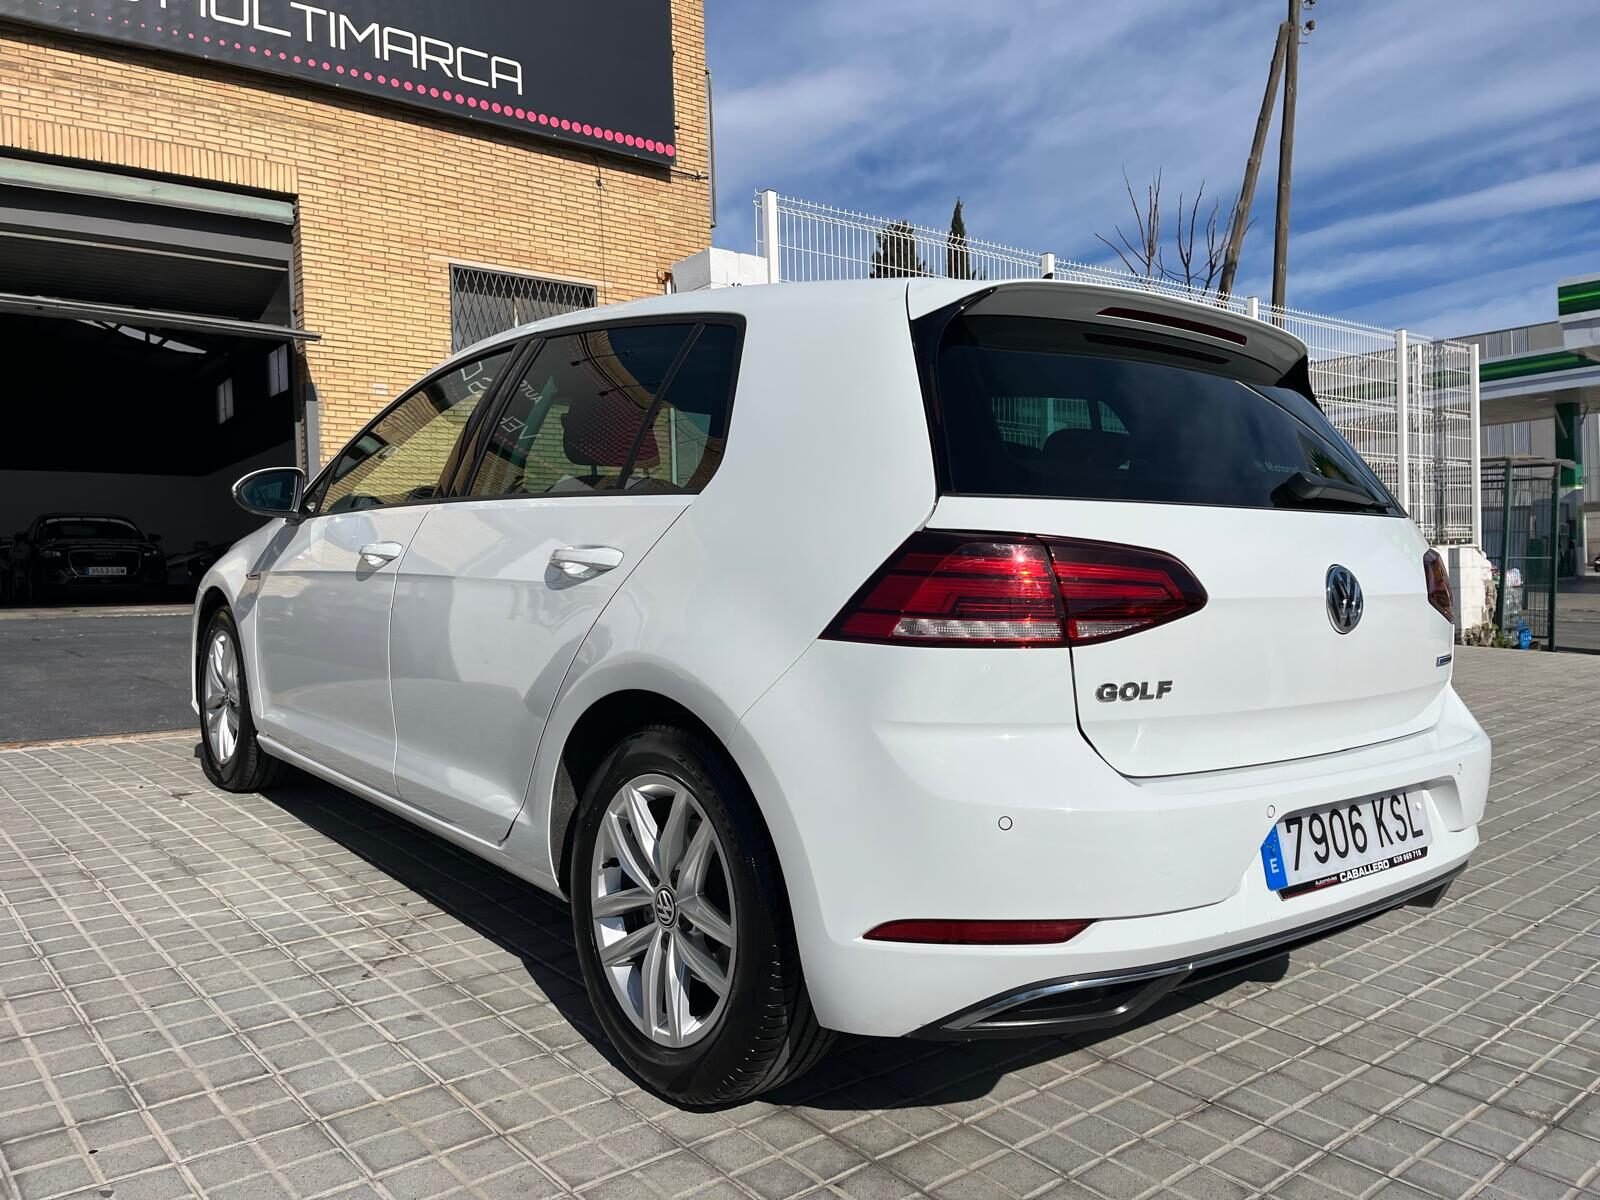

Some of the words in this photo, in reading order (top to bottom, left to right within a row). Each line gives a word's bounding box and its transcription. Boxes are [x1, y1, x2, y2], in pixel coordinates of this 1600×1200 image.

[1095, 680, 1173, 703] GOLF
[1270, 858, 1280, 874] E
[1285, 804, 1368, 871] 7906
[1371, 792, 1424, 848] KSL
[1339, 860, 1390, 882] CABALLERO
